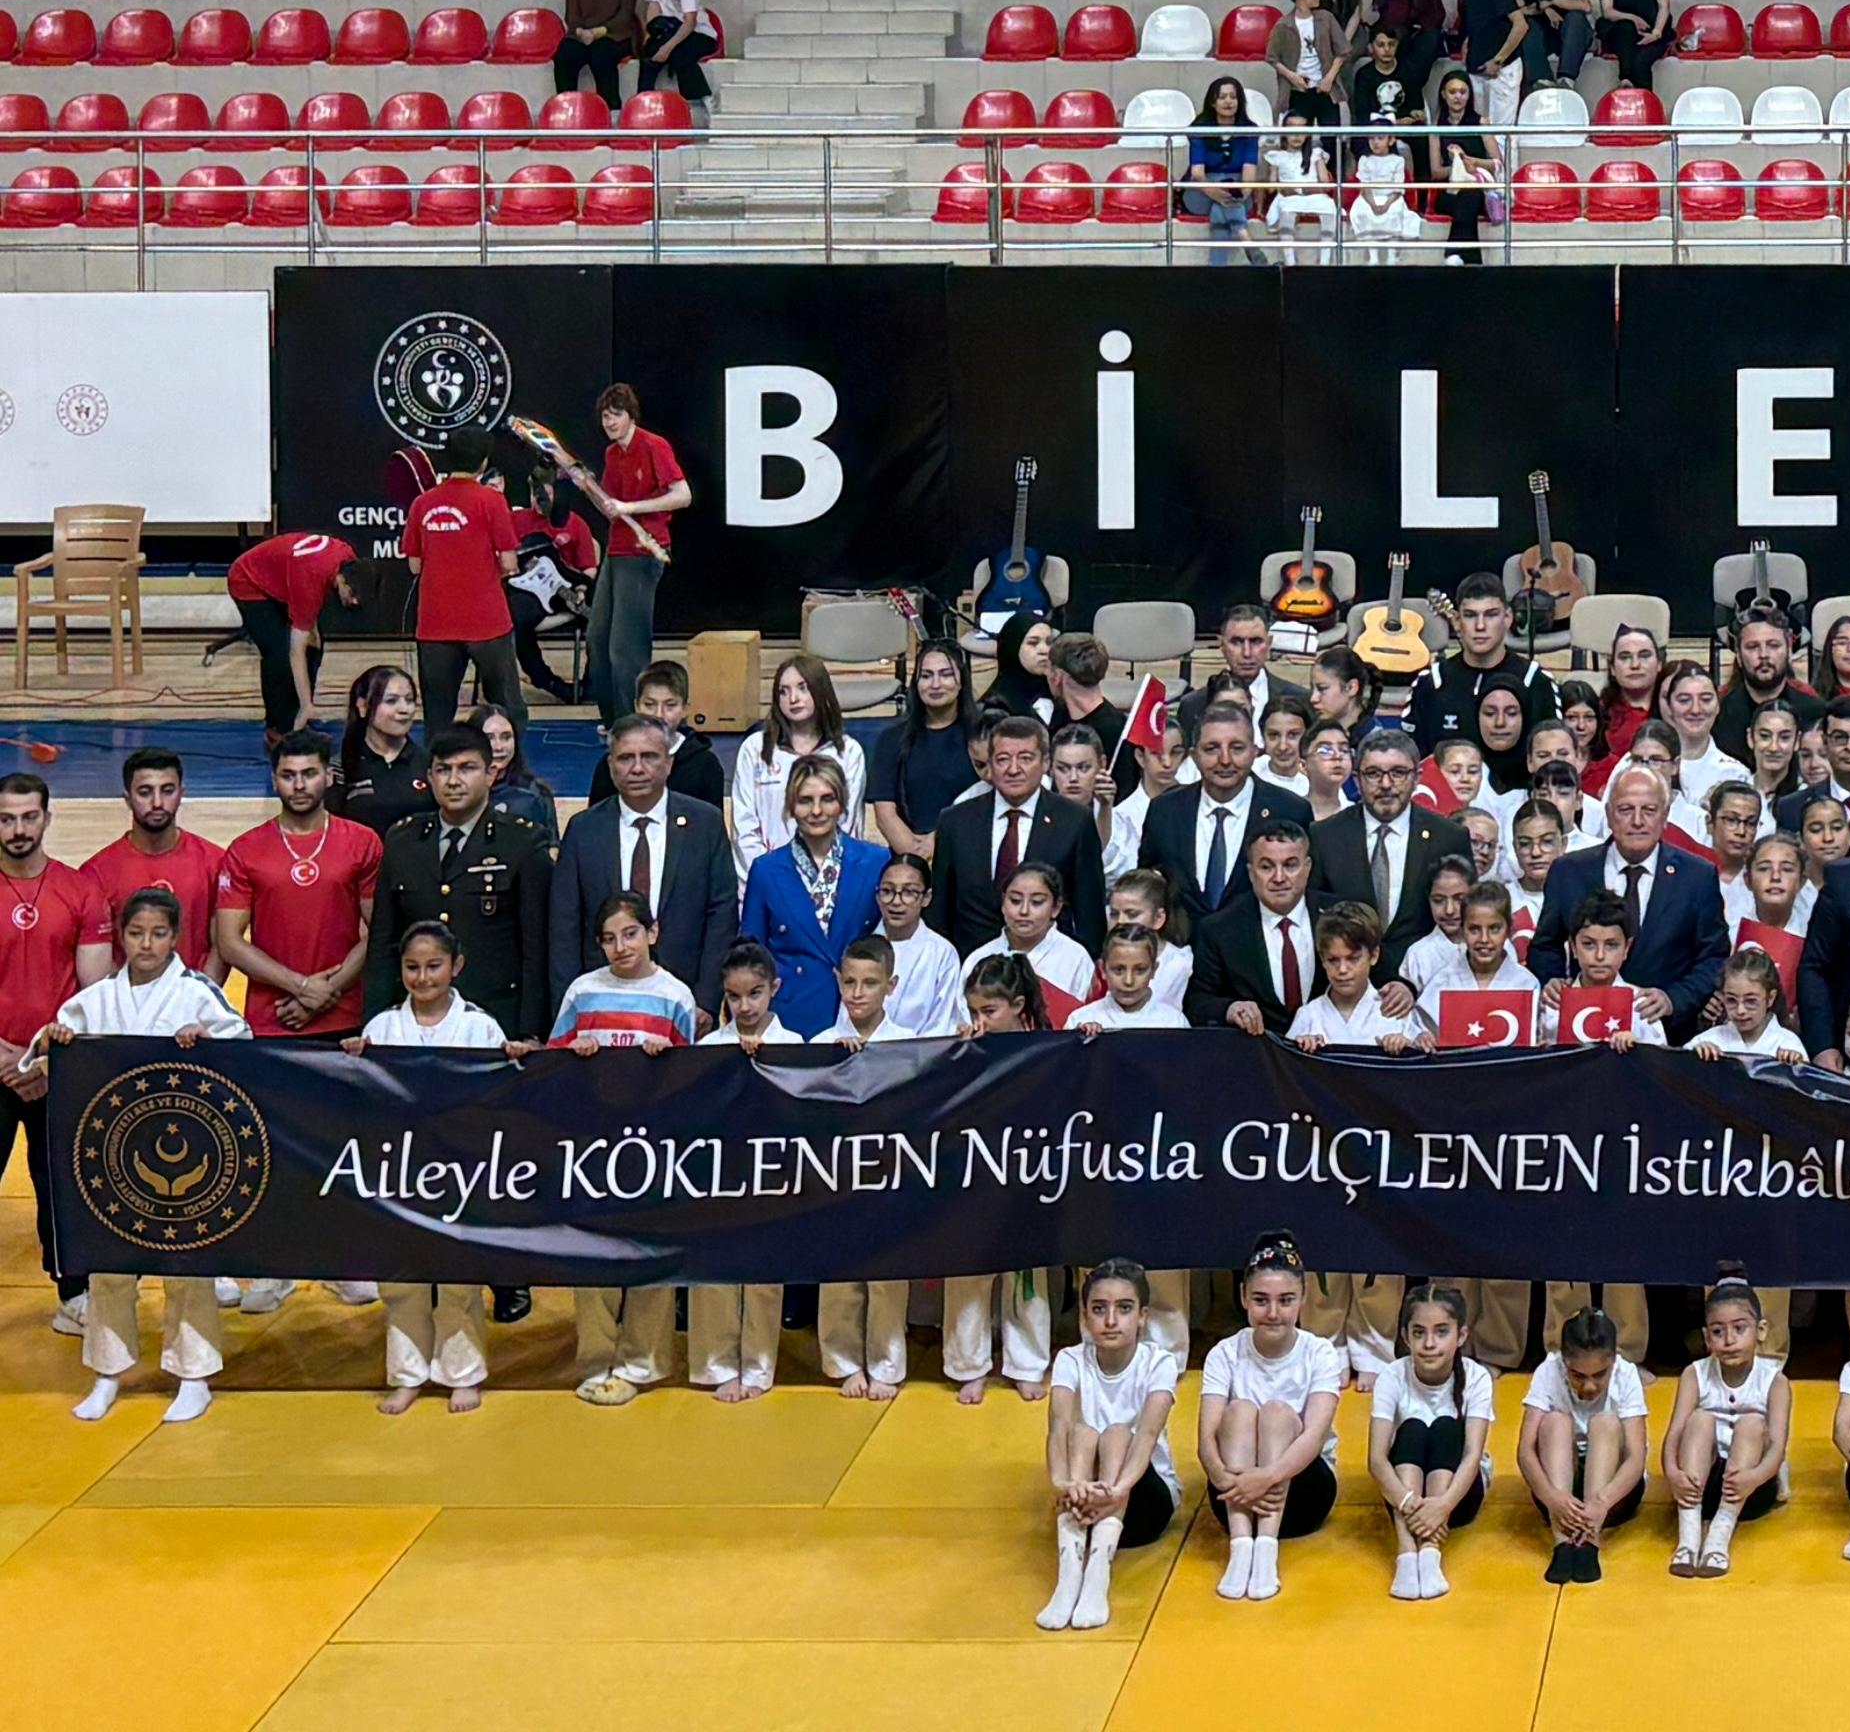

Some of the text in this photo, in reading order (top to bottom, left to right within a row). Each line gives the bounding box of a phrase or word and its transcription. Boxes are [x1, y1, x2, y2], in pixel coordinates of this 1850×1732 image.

[319, 1130, 537, 1224] Aileyle
[560, 1126, 941, 1200] KÖKLENEN
[960, 1110, 1203, 1204] Nüfusla
[1221, 1112, 1604, 1205] GÜÇLENEN
